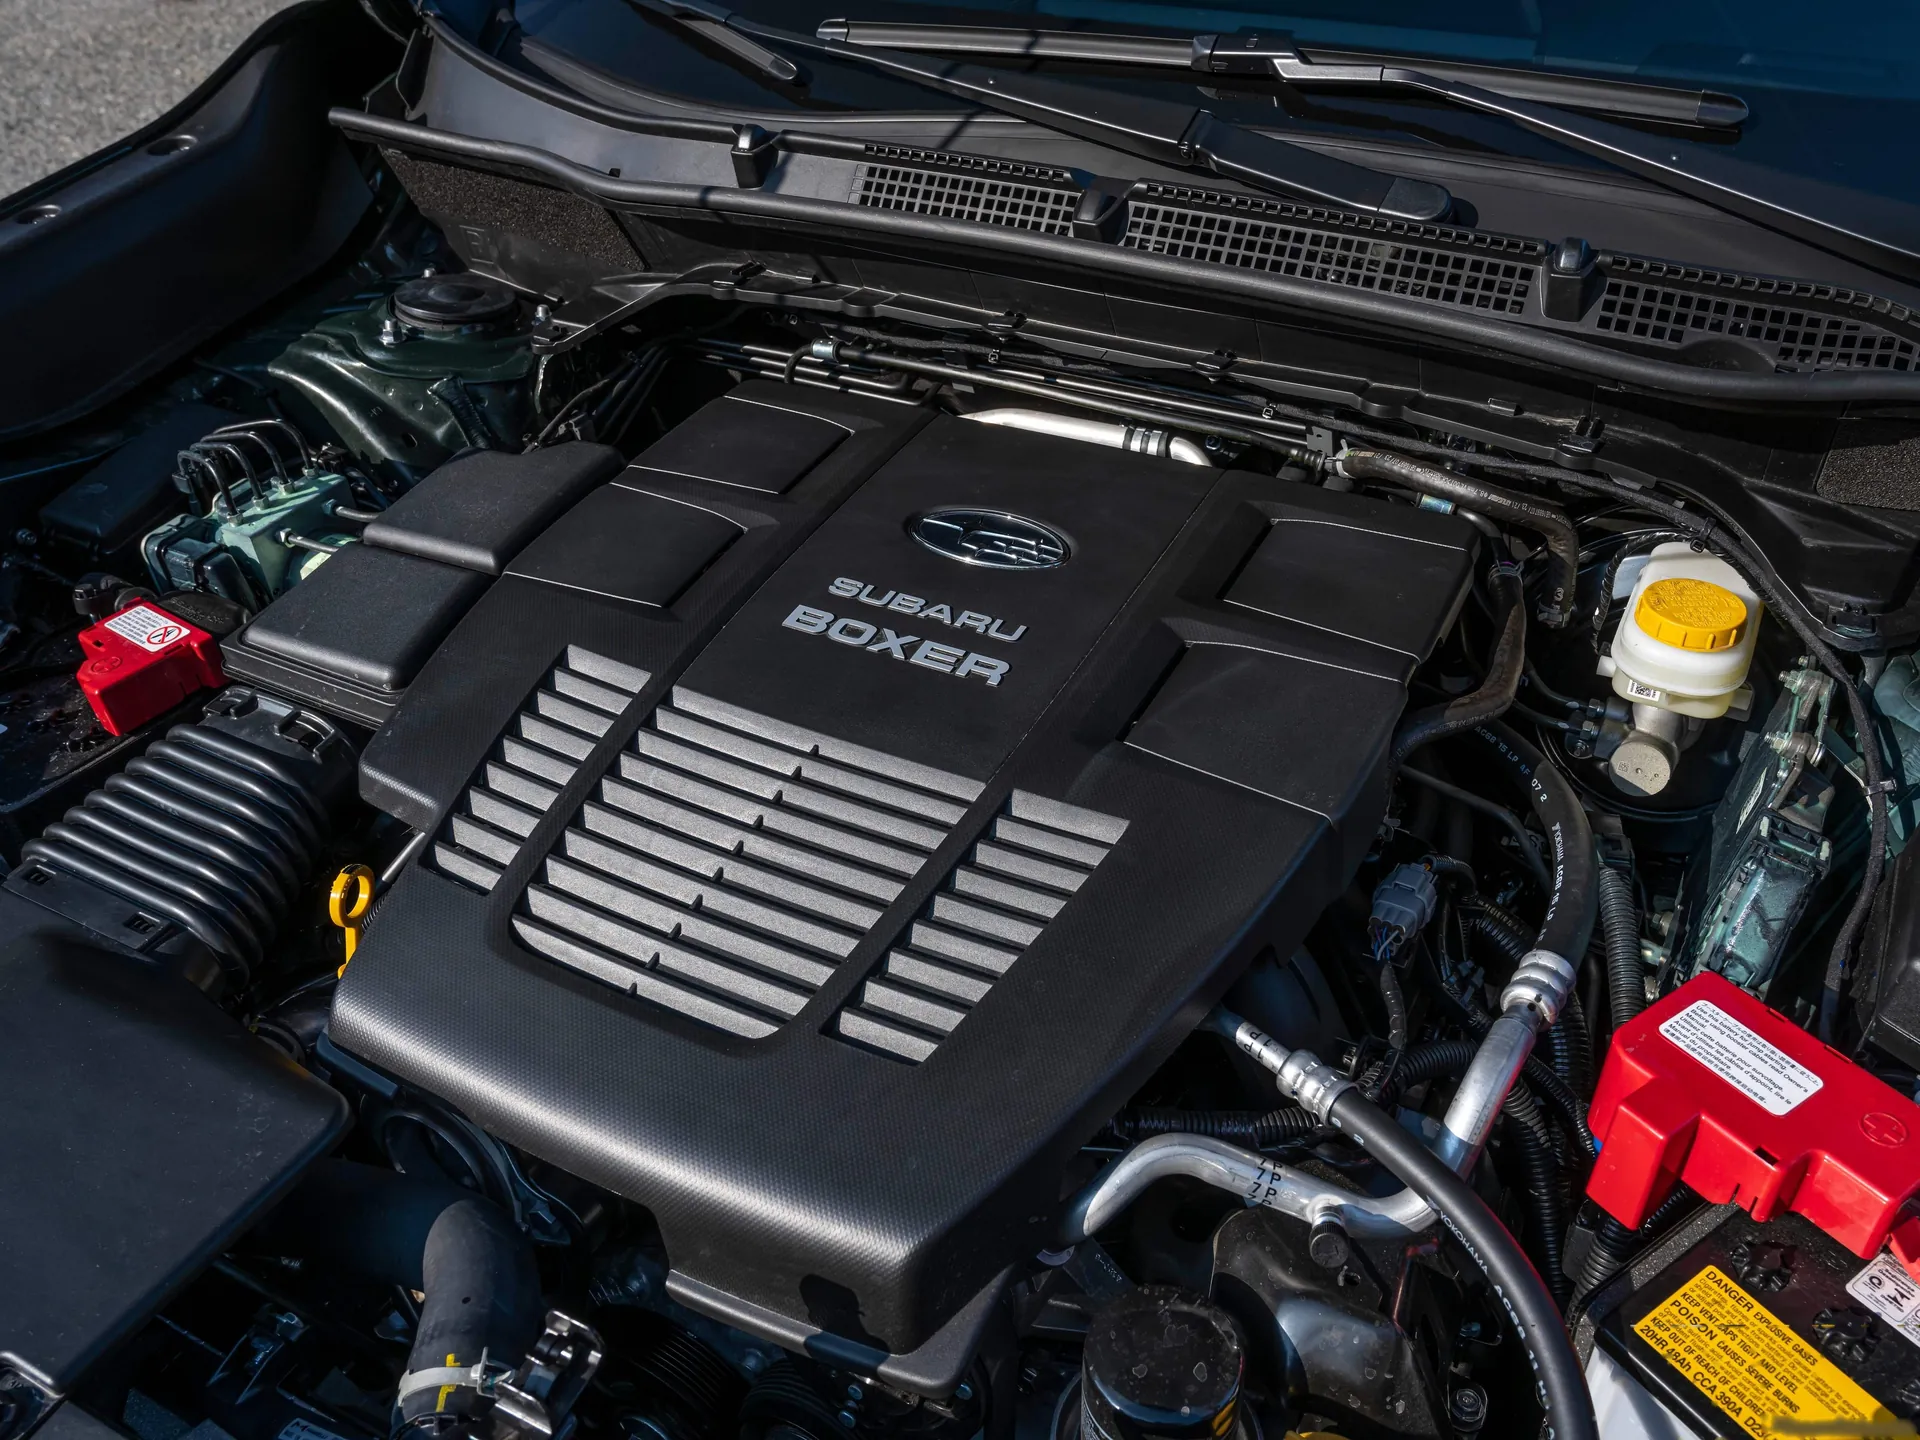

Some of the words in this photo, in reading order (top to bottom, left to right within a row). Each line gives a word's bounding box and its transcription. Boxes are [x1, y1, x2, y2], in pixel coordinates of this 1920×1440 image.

[781, 603, 1012, 688] BOXER
[828, 576, 1029, 642] SUBARU
[1498, 742, 1507, 753] 15
[1507, 750, 1519, 762] LP
[1531, 778, 1542, 791] 07
[1666, 1023, 1691, 1040] Manuel
[1688, 1038, 1699, 1046] du
[1672, 1019, 1692, 1032] Avant
[1689, 1031, 1716, 1050] d'utiliser
[1713, 1048, 1725, 1057] les
[1722, 1055, 1745, 1071] câbles
[1772, 1090, 1786, 1100] lire
[1678, 1015, 1702, 1032] Utilisez
[1698, 1030, 1716, 1042] cette
[1713, 1040, 1739, 1058] batterie
[1735, 1056, 1752, 1069] pour
[1689, 1008, 1711, 1023] Before
[1707, 1022, 1727, 1035] using
[1724, 1033, 1750, 1050] booster
[1746, 1048, 1770, 1064] cables
[1767, 1062, 1784, 1075] read
[1781, 1072, 1810, 1093] Owner's
[1694, 1005, 1709, 1015] Use
[1706, 1013, 1720, 1022] this
[1716, 1020, 1740, 1037] battery
[1746, 1041, 1765, 1054] jump
[1761, 1052, 1789, 1071] starting.
[1440, 1212, 1488, 1276] YOKOHAMA
[1656, 1310, 1667, 1319] of
[1688, 1338, 1706, 1353] flush
[1718, 1364, 1738, 1381] water
[1736, 1379, 1751, 1392] and
[1748, 1390, 1762, 1402] call
[1661, 1306, 1690, 1330] Contains
[1686, 1326, 1712, 1349] sulfuric
[1723, 1359, 1743, 1377] Avoid
[1740, 1374, 1765, 1396] contact
[1762, 1394, 1781, 1410] with
[1668, 1299, 1718, 1341] POISON
[1715, 1340, 1747, 1367] CAUSES
[1743, 1364, 1775, 1391] SEVERE
[1770, 1388, 1801, 1414] BURNS
[1679, 1291, 1701, 1309] KEEP
[1697, 1306, 1720, 1325] VENT
[1756, 1356, 1778, 1374] AND
[1773, 1371, 1801, 1394] LEVEL
[1687, 1286, 1697, 1294] or
[1694, 1291, 1715, 1309] adjust
[1711, 1307, 1727, 1320] post
[1759, 1347, 1784, 1368] without
[1781, 1366, 1805, 1386] proper
[1692, 1282, 1712, 1298] shield
[1709, 1296, 1726, 1311] eyes
[1724, 1308, 1738, 1320] and
[1748, 1329, 1766, 1344] from
[1786, 1361, 1799, 1371] Do
[1795, 1369, 1809, 1381] not
[1805, 1378, 1830, 1400] charge
[1827, 1397, 1838, 1406] or
[1835, 1403, 1850, 1416] use
[1704, 1269, 1755, 1312] DANGER
[1751, 1310, 1794, 1346] EXPLOSIVE
[1790, 1342, 1819, 1367] GASES
[1728, 1303, 1751, 1322] flames
[1748, 1320, 1758, 1328] or
[1755, 1326, 1778, 1346] sparks
[1774, 1342, 1794, 1359] could
[1791, 1356, 1812, 1374] cause
[1833, 1391, 1844, 1401] to
[1638, 1323, 1669, 1350] 20HR
[1662, 1345, 1694, 1373] 48Ah
[1690, 1369, 1720, 1395] CCA
[1713, 1390, 1745, 1417] 390A
[1649, 1315, 1671, 1334] KEEP
[1666, 1330, 1686, 1347] OUT
[1682, 1344, 1697, 1357] OF
[1692, 1353, 1721, 1378] REACH
[1716, 1374, 1732, 1388] OF
[1727, 1383, 1766, 1418] CHILDRE
